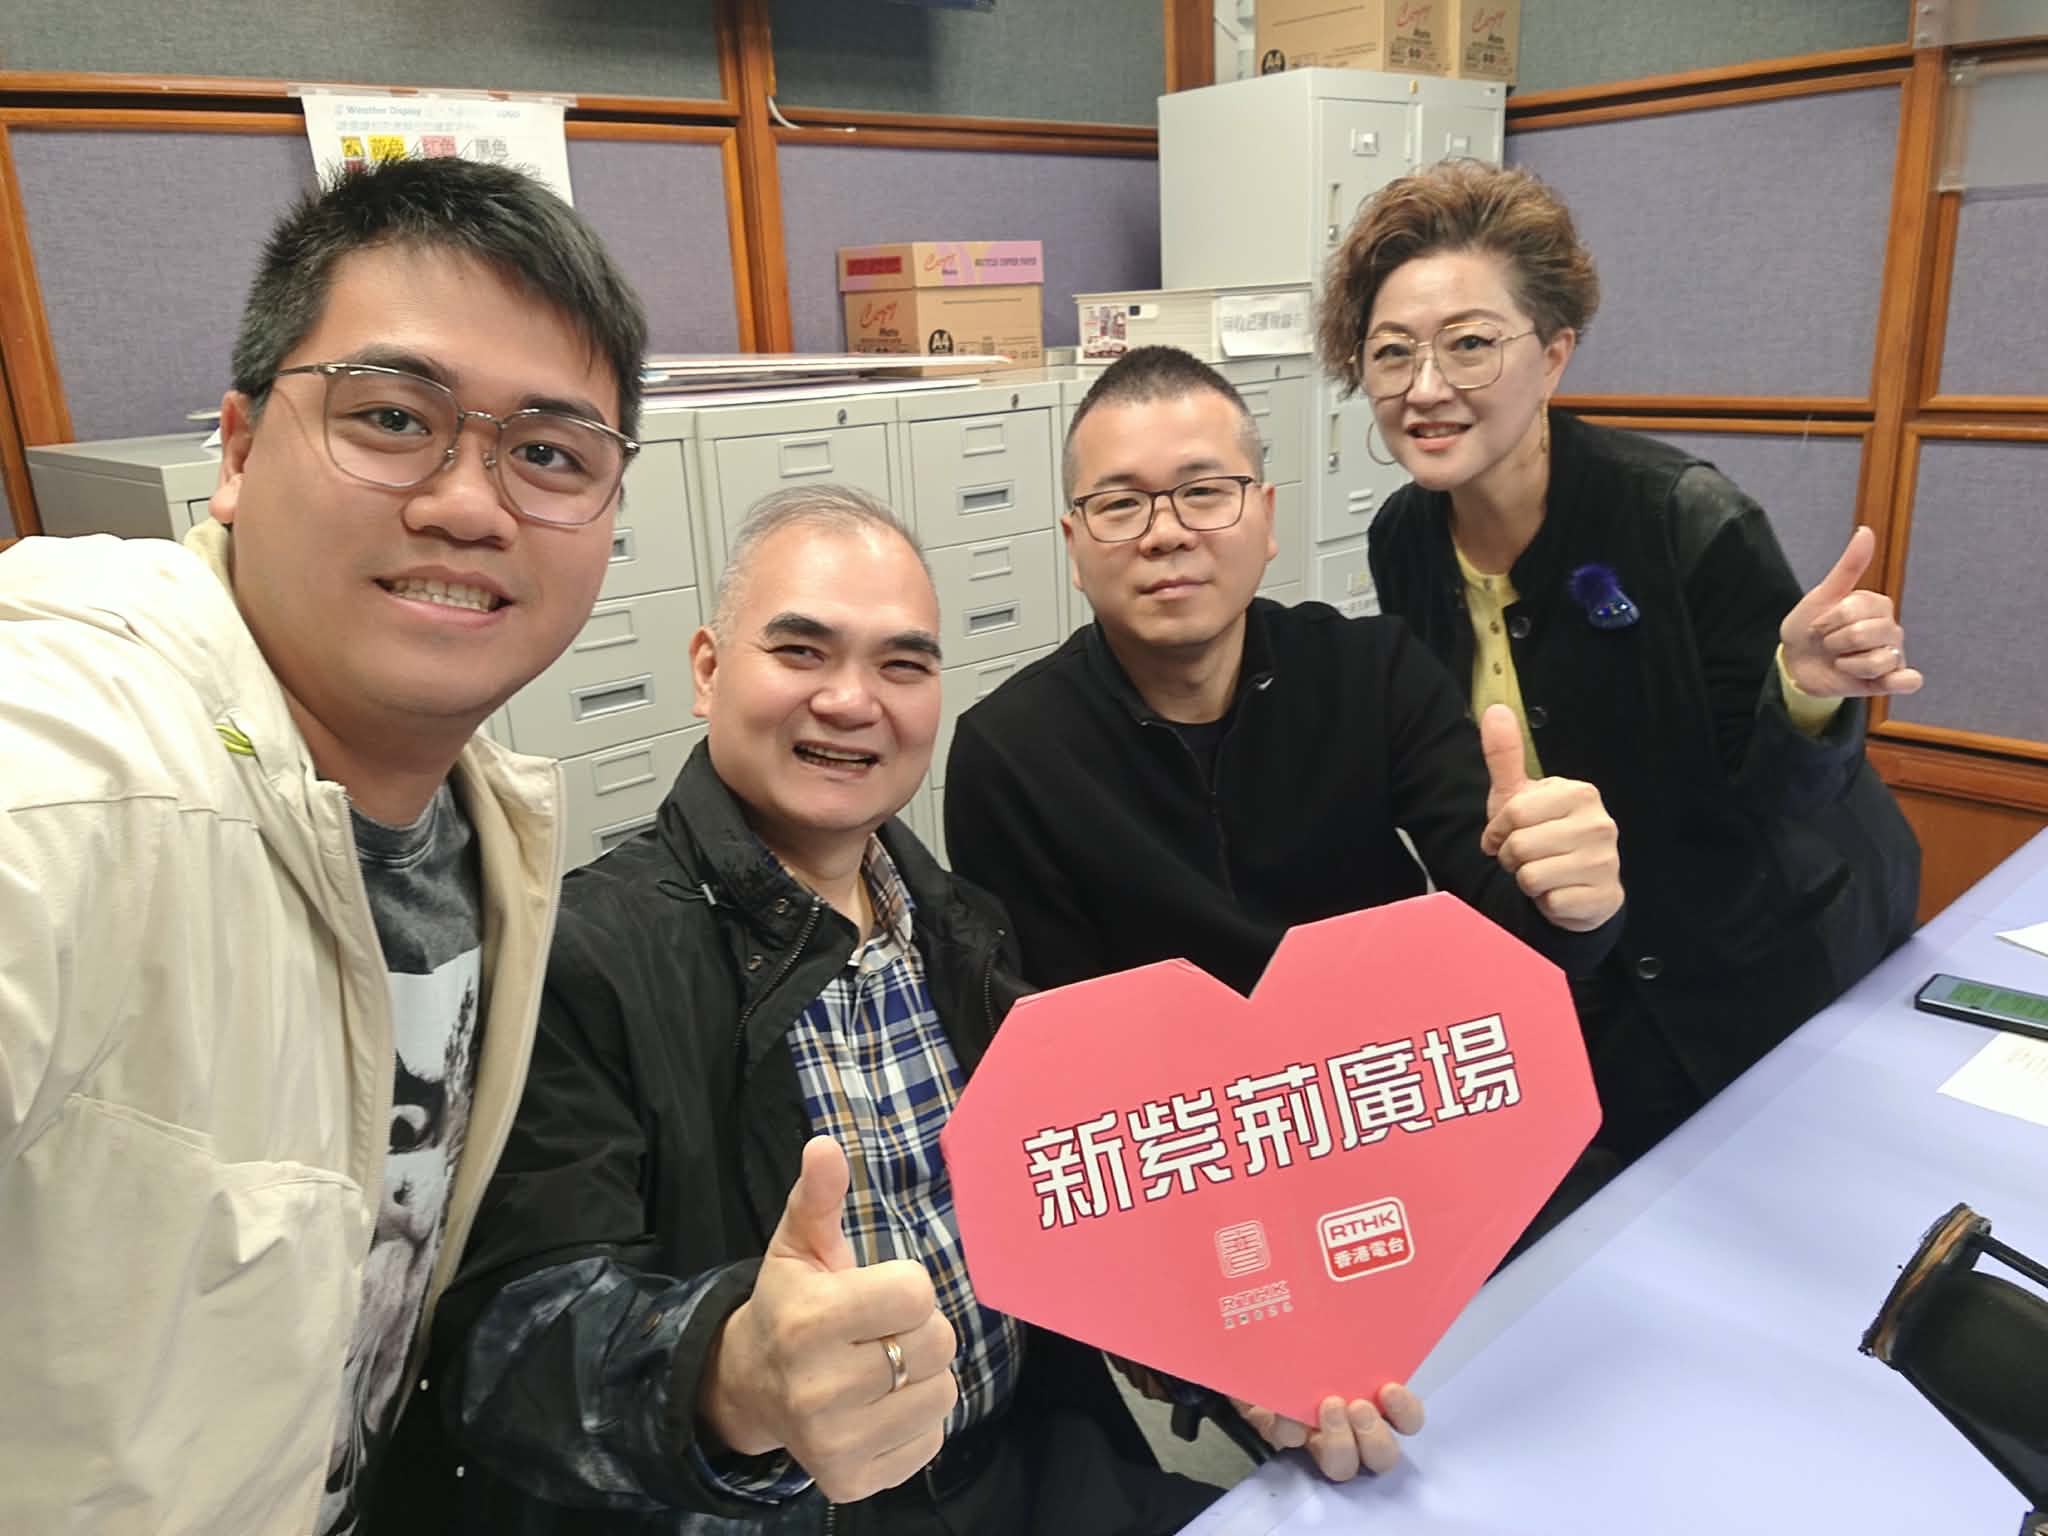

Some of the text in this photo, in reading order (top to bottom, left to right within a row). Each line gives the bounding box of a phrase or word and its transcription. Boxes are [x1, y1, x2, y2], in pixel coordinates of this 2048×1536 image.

[1023, 1012, 1522, 1230] 新紫荊廣場
[1329, 1210, 1396, 1241] RTHK
[1333, 1237, 1405, 1269] 香港電台
